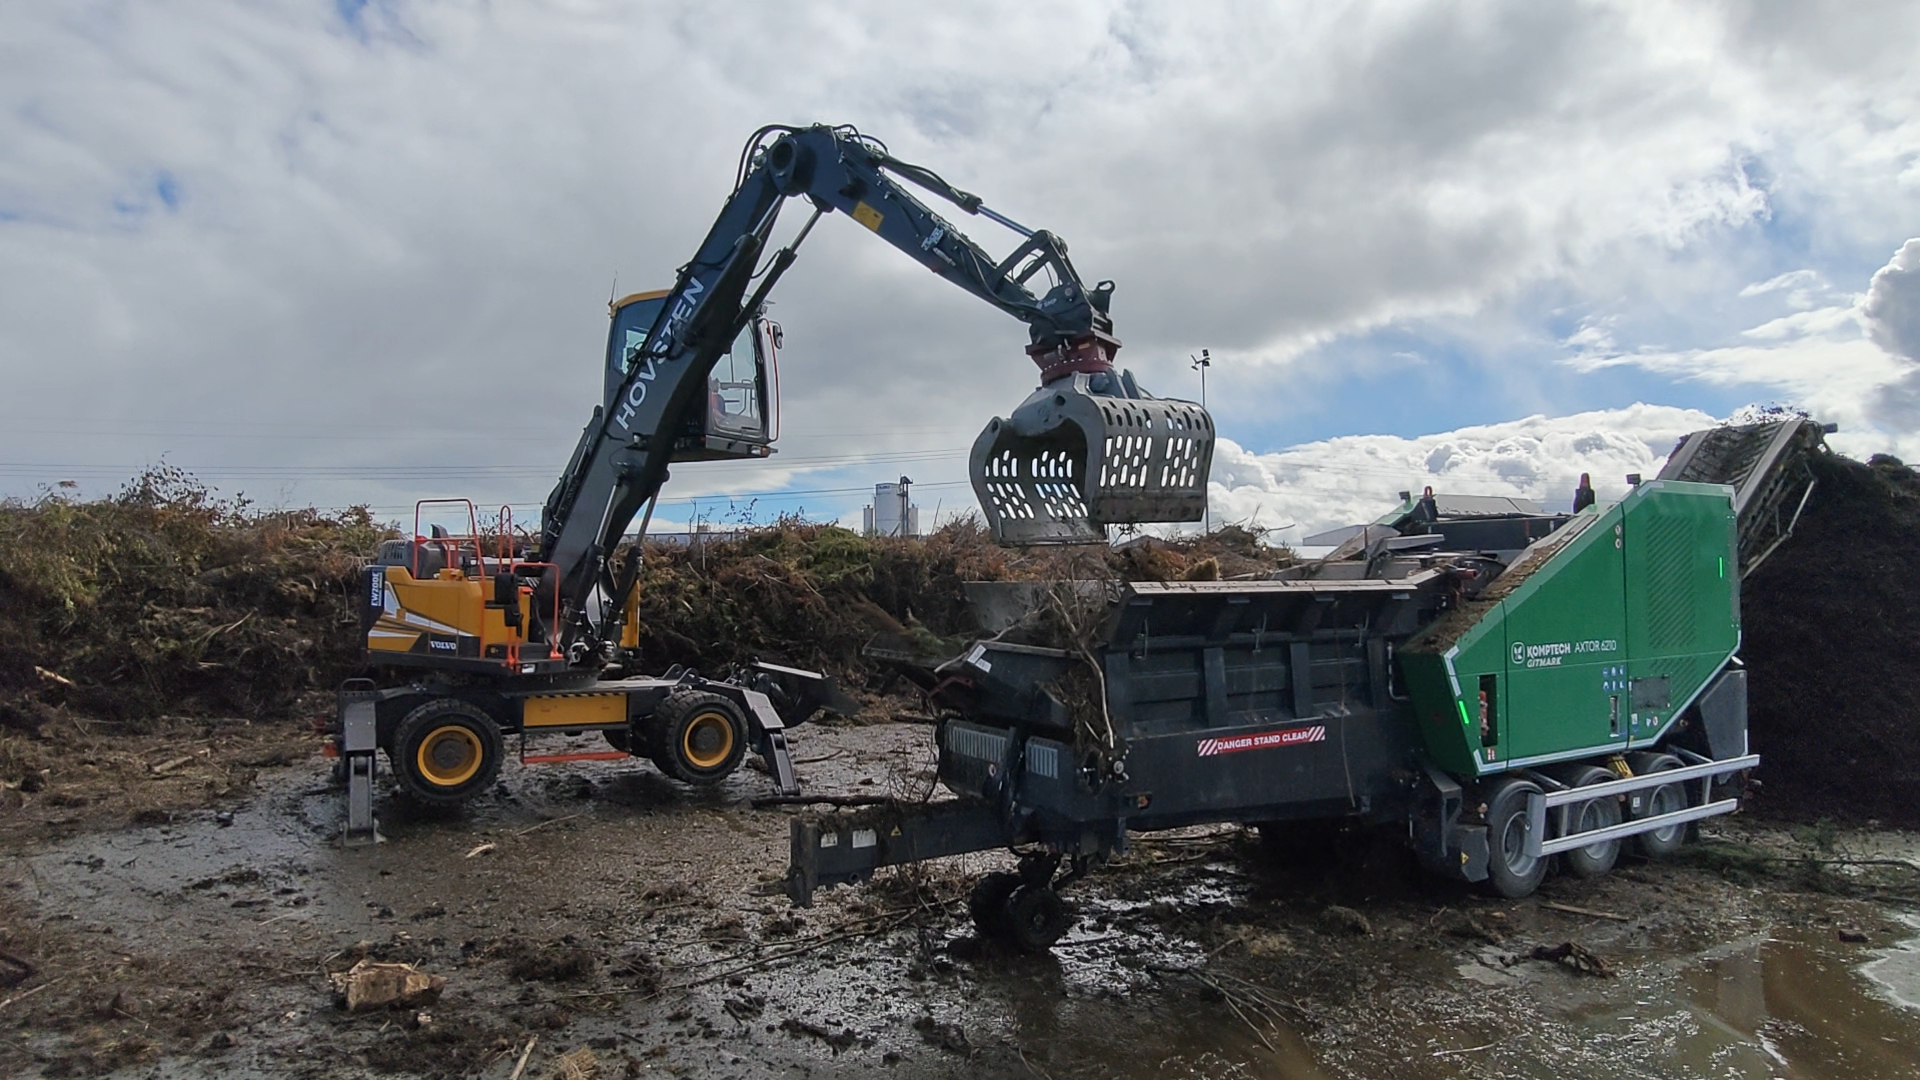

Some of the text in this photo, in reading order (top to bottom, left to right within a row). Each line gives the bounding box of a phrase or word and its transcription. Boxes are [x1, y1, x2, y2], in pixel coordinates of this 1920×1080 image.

[616, 276, 704, 430] HOVSTEN
[430, 640, 457, 650] VOLVO
[1527, 640, 1617, 658] KOMPTECH AXTOR 6210
[1527, 657, 1562, 668] GITMARK
[1217, 731, 1309, 750] DANGER STAND CLEAR
